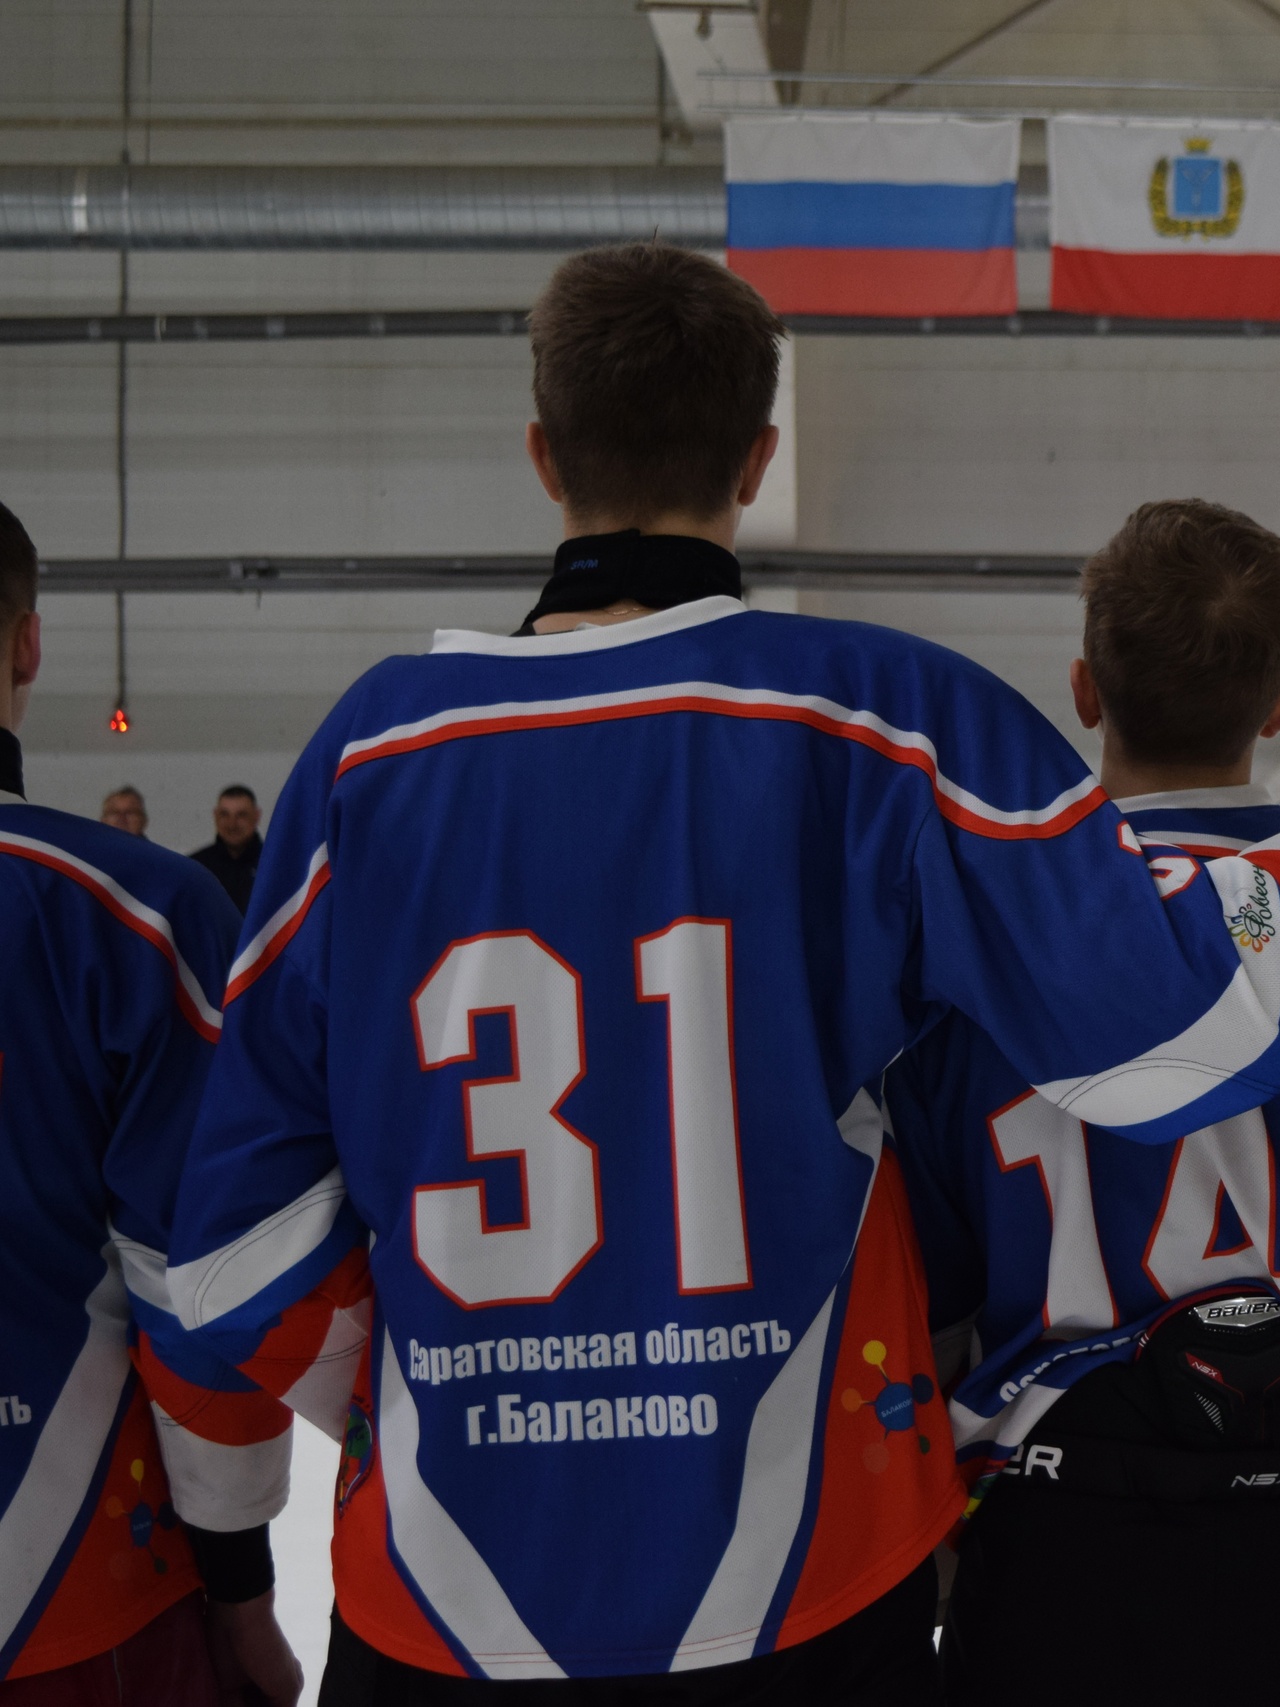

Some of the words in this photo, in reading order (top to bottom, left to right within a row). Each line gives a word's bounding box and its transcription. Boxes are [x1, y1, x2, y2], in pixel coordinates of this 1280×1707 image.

[410, 915, 754, 1311] 31
[409, 1331, 637, 1386] Саратовская
[645, 1319, 792, 1367] область
[1191, 1361, 1219, 1378] NSX
[467, 1393, 719, 1446] г.Балаково
